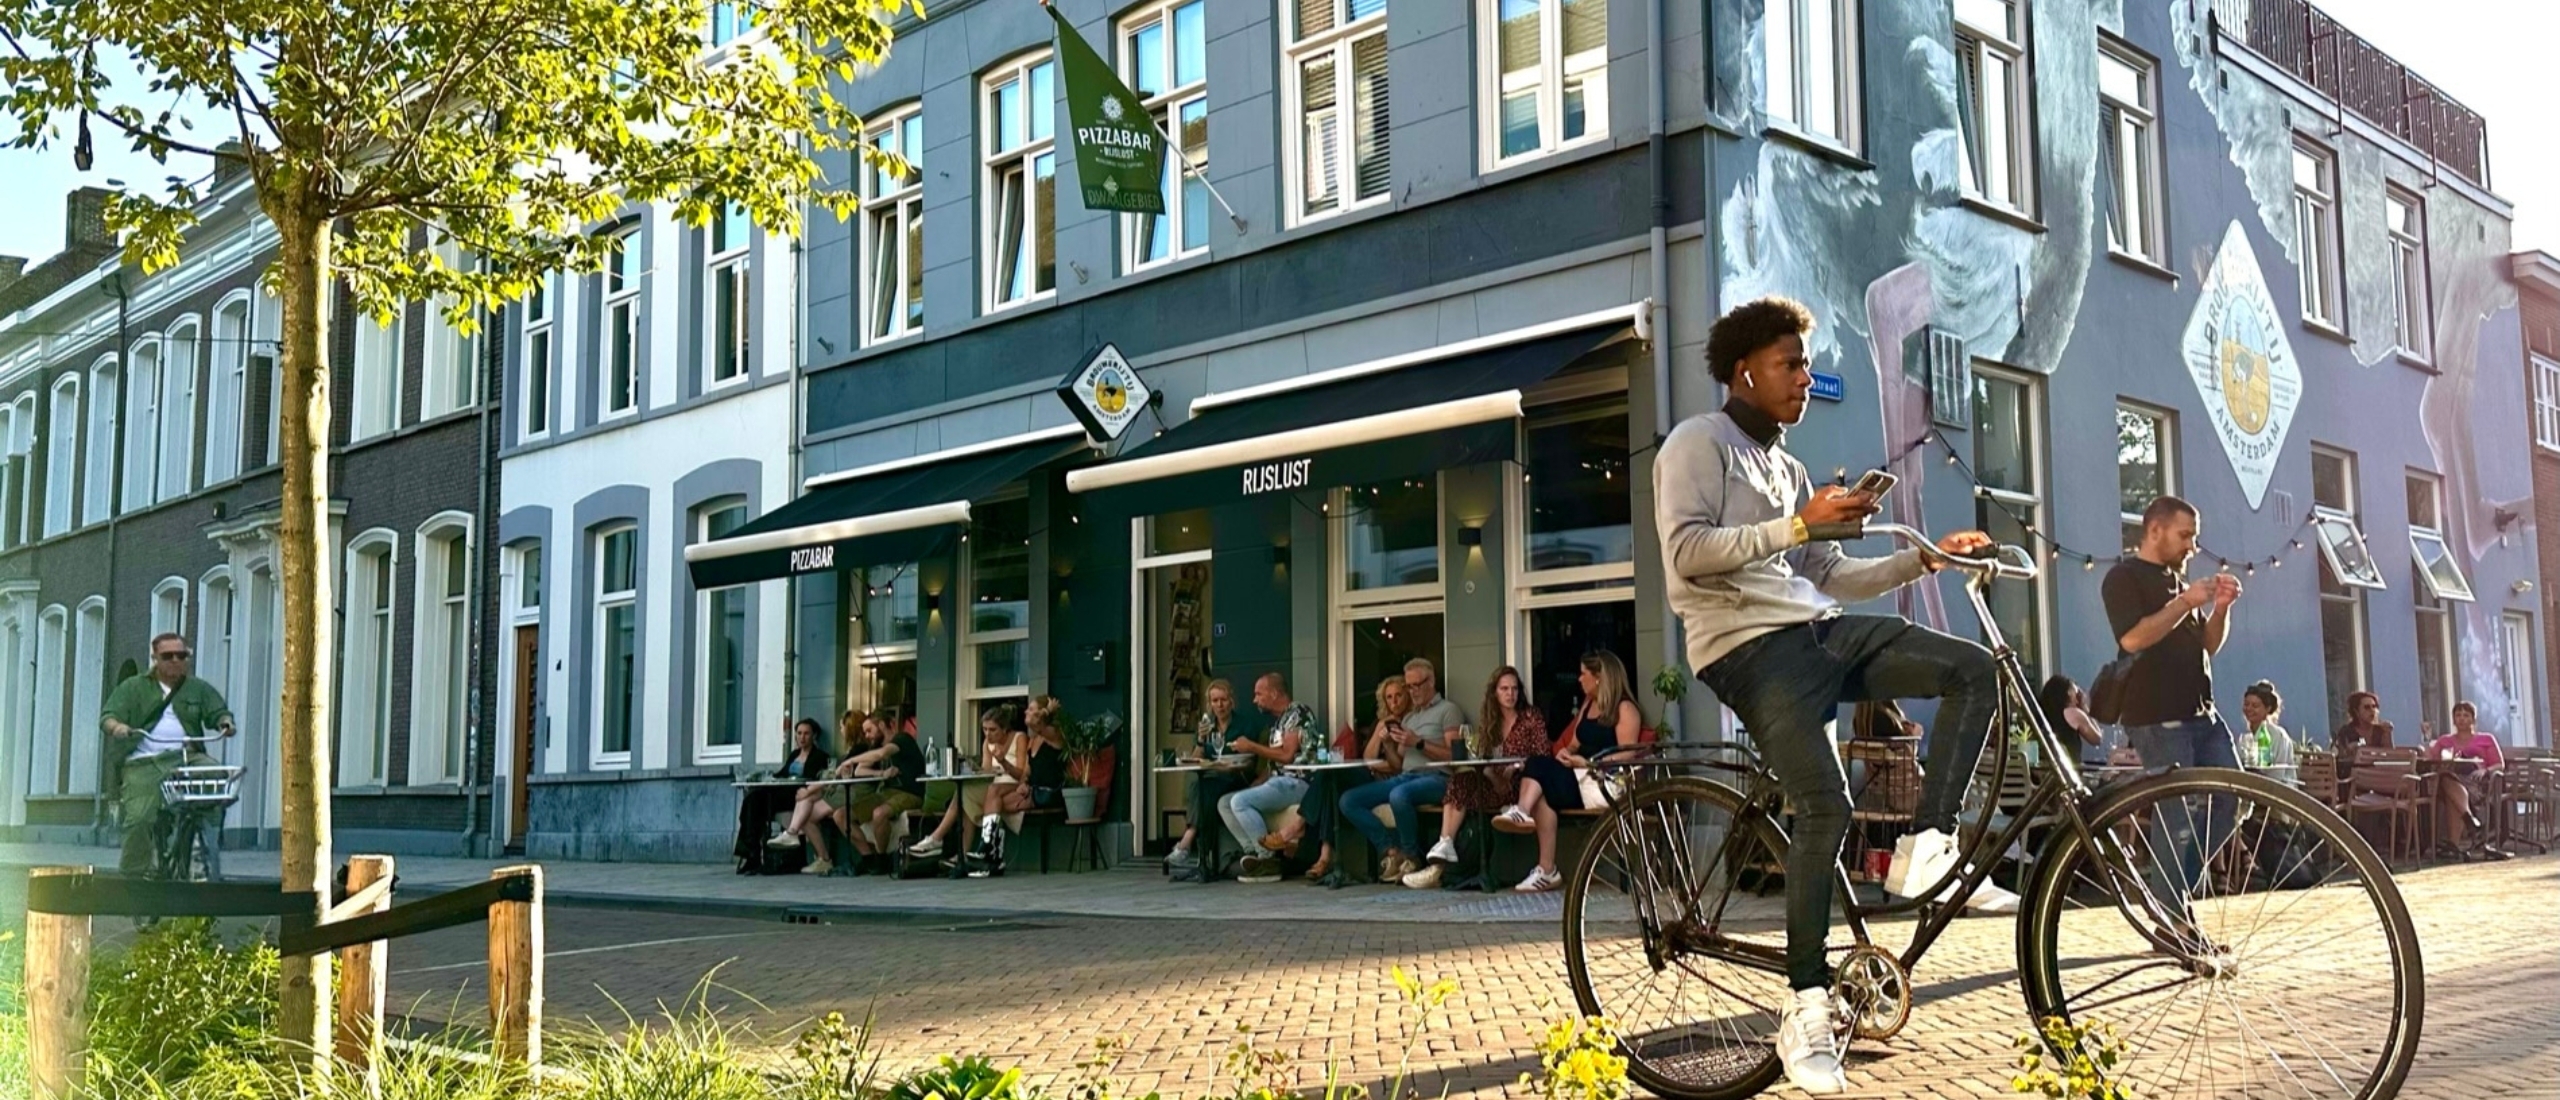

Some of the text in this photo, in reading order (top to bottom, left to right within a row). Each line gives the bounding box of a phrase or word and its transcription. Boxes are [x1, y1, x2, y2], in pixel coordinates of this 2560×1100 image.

[1078, 127, 1151, 151] PIZZABAR
[1092, 404, 1131, 421] AMSTERDAM
[2216, 407, 2280, 461] AMSTERDAM
[1243, 458, 1312, 495] RIJSLUST
[791, 545, 834, 572] PIZZABAR
